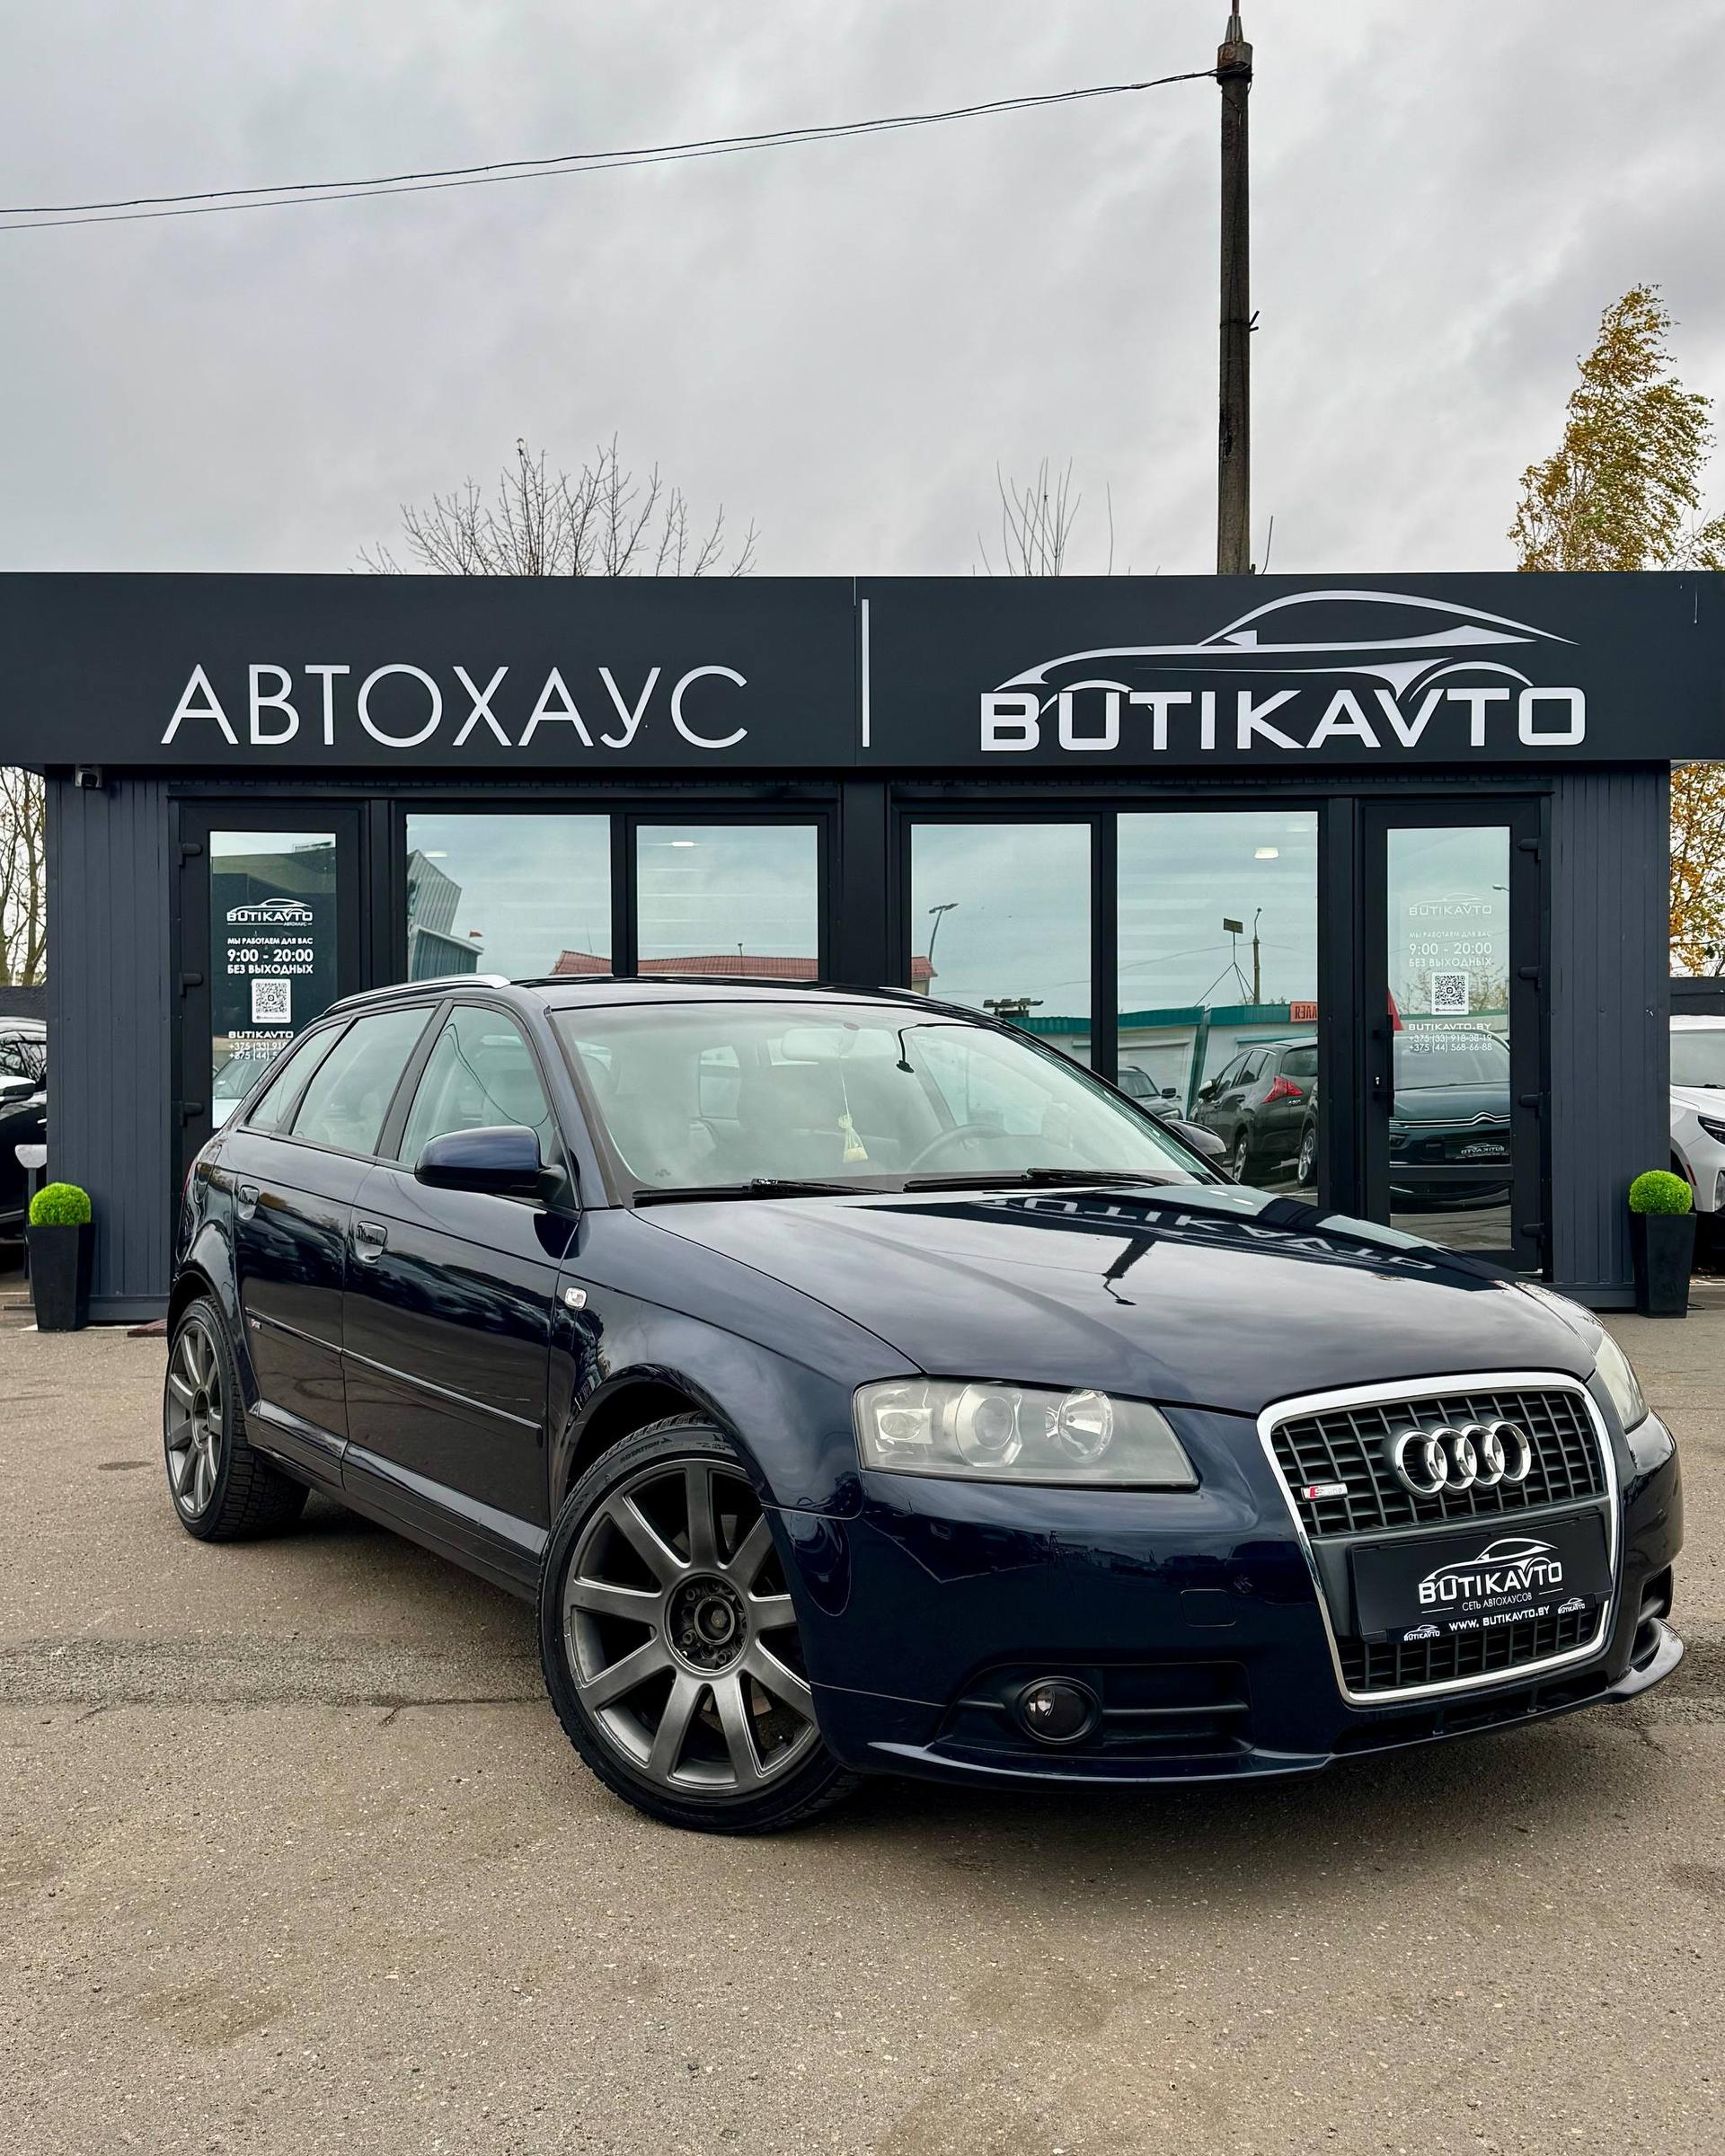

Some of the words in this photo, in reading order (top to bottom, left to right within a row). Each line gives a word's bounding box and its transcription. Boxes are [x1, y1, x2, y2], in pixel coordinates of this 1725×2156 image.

[161, 663, 748, 749] АВТОХАУС
[980, 686, 1586, 752] BUTIKAVTO
[1409, 906, 1492, 915] BUTIKAVTO
[226, 911, 314, 922] BUTIKAVTO
[1409, 943, 1438, 955] 9:00
[1455, 941, 1492, 954] 20:00
[227, 949, 259, 962] 9:00
[273, 949, 314, 962] 20:00
[1409, 958, 1426, 967] БЕЗ
[1429, 958, 1491, 967] ВЫХОДНЫХ
[227, 965, 245, 974] БЕЗ
[248, 964, 314, 975] ВЫХОДНЫХ
[228, 1030, 294, 1038] BUTIKAVTO
[1432, 1034, 1448, 1045] (33)
[1450, 1034, 1492, 1042] 918-38-19
[229, 1042, 251, 1050] +375
[252, 1041, 270, 1052] (33)
[1432, 1043, 1448, 1053] (44)
[1450, 1043, 1492, 1051] 568-66-88
[252, 1050, 270, 1061] (44)
[1418, 1561, 1562, 1604] BUTIKAVTO
[1462, 1600, 1482, 1612] СЕТЬ
[1482, 1592, 1533, 1609] АВТОХАУСОВ
[1557, 1603, 1586, 1614] BUTIKAVTO
[1448, 1619, 1479, 1631] WWW.
[1482, 1605, 1550, 1627] BUTIKAVTO.BY
[1403, 1630, 1440, 1641] BUTIKAVTO
